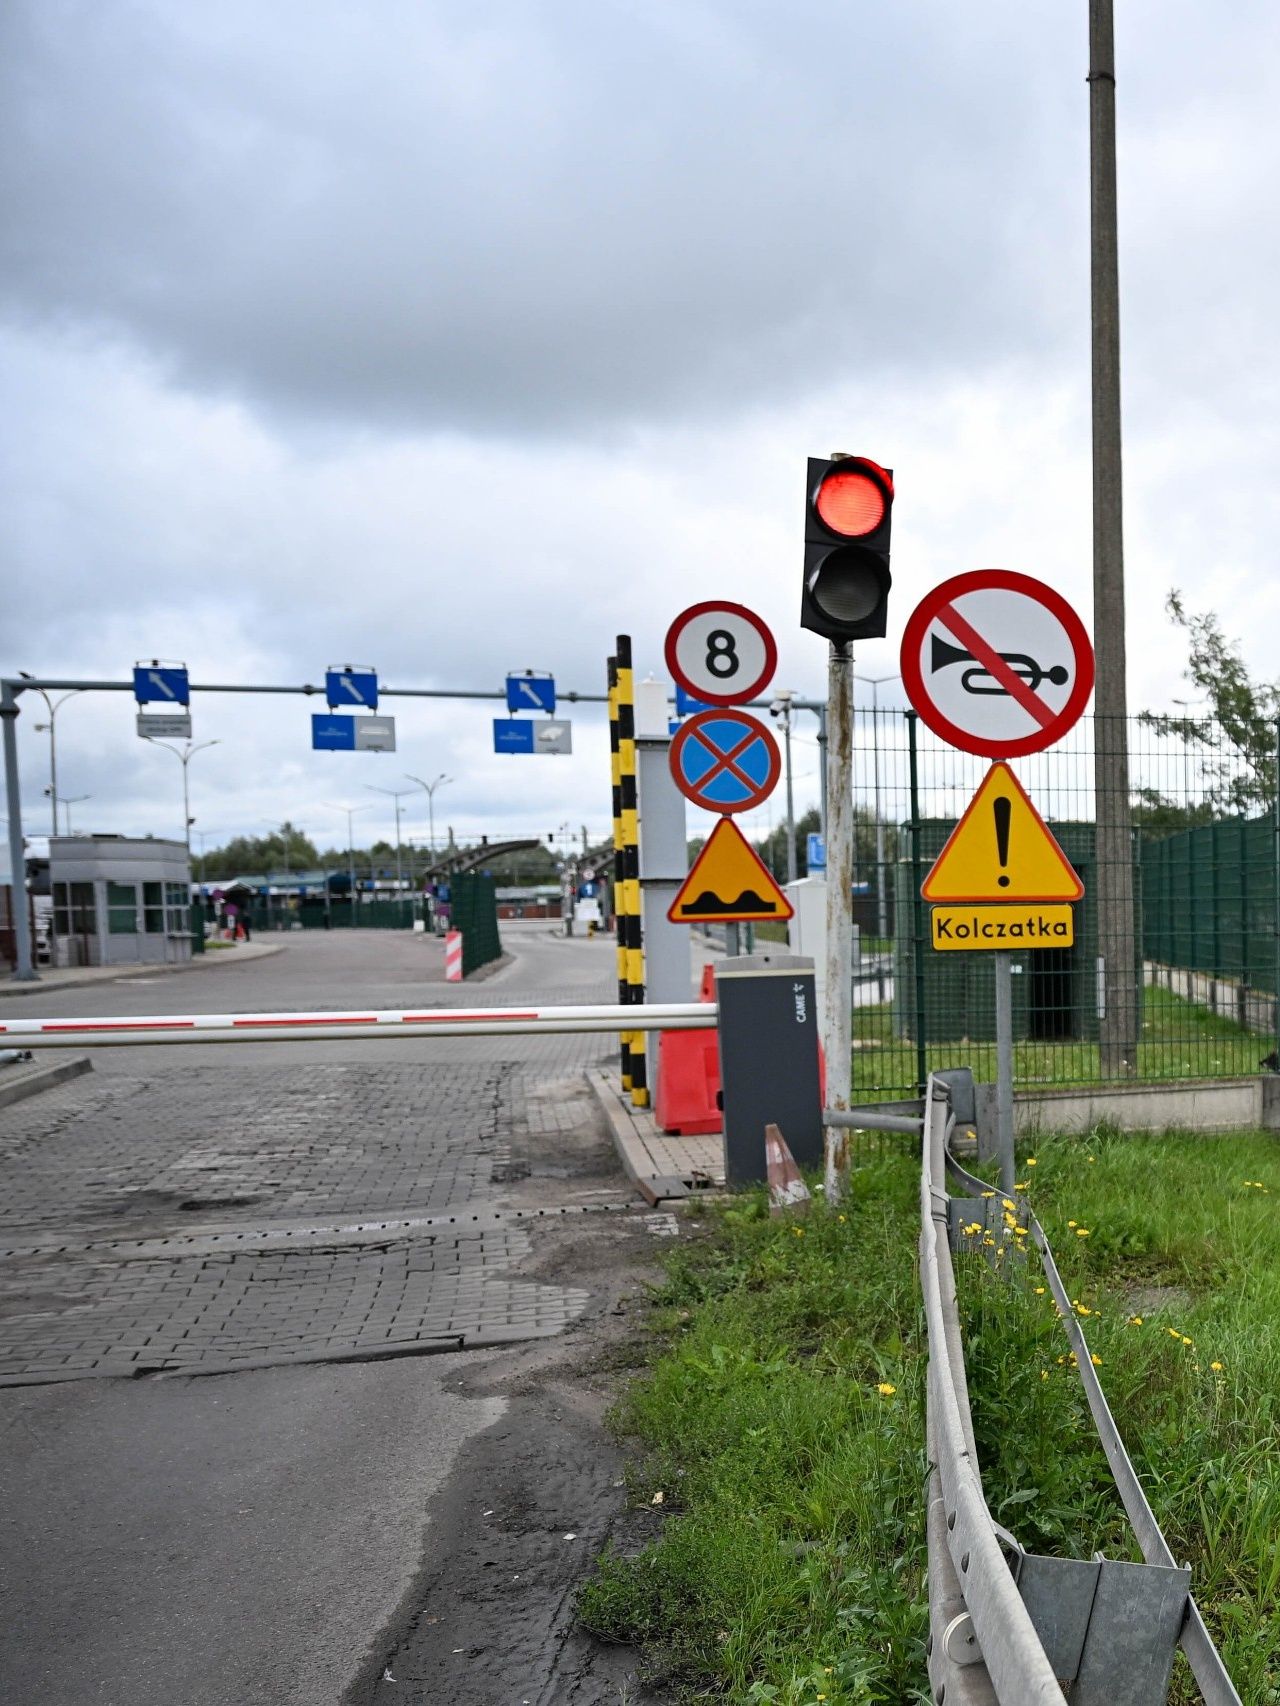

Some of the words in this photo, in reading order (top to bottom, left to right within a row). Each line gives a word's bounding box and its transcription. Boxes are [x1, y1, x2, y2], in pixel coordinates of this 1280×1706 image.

[705, 628, 740, 679] 8
[936, 915, 1068, 939] Kolczatka
[795, 993, 807, 1023] CAME
